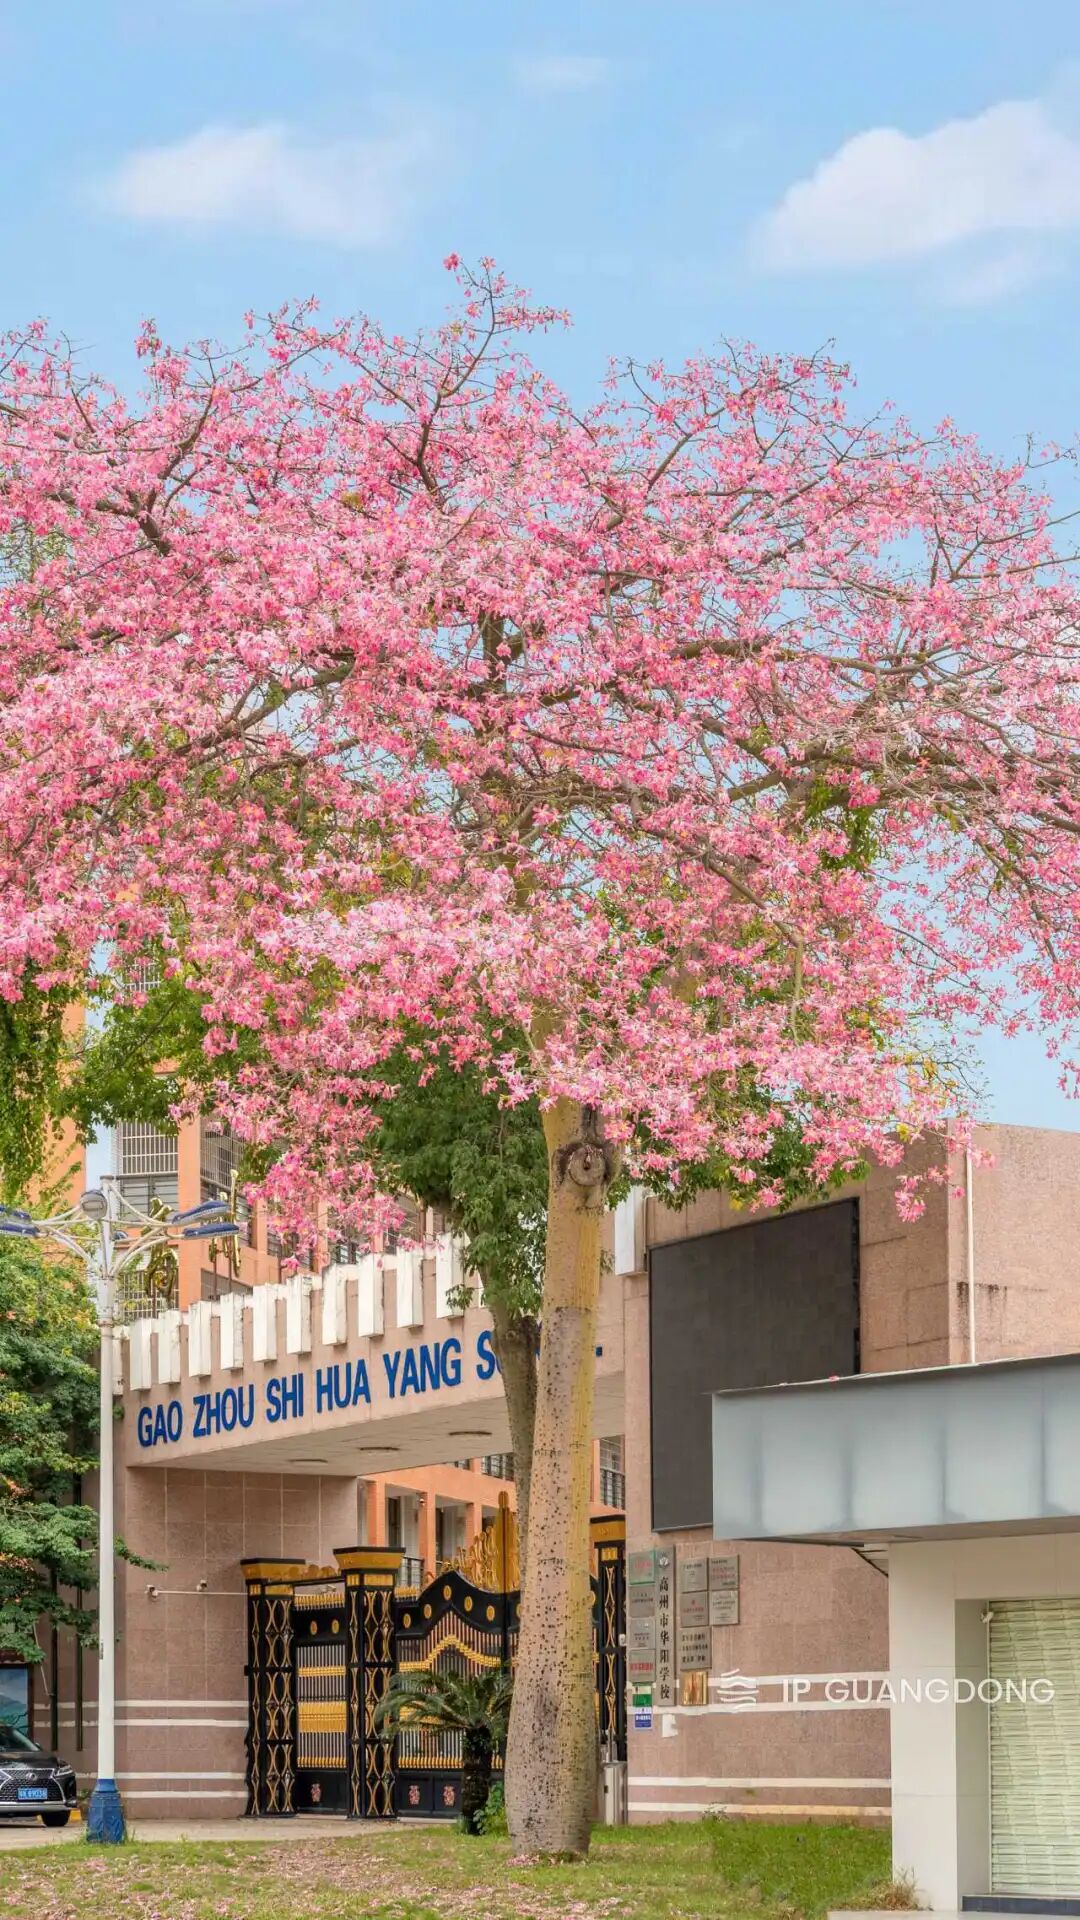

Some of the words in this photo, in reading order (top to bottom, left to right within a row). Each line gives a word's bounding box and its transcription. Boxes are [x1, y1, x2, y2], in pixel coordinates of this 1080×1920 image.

[138, 1405, 183, 1448] GAO
[193, 1384, 254, 1437] ZHOU
[266, 1374, 304, 1422] SHI
[316, 1359, 371, 1413] HUA
[383, 1338, 461, 1399] YANG
[658, 1576, 671, 1701] 高州市华阳学校
